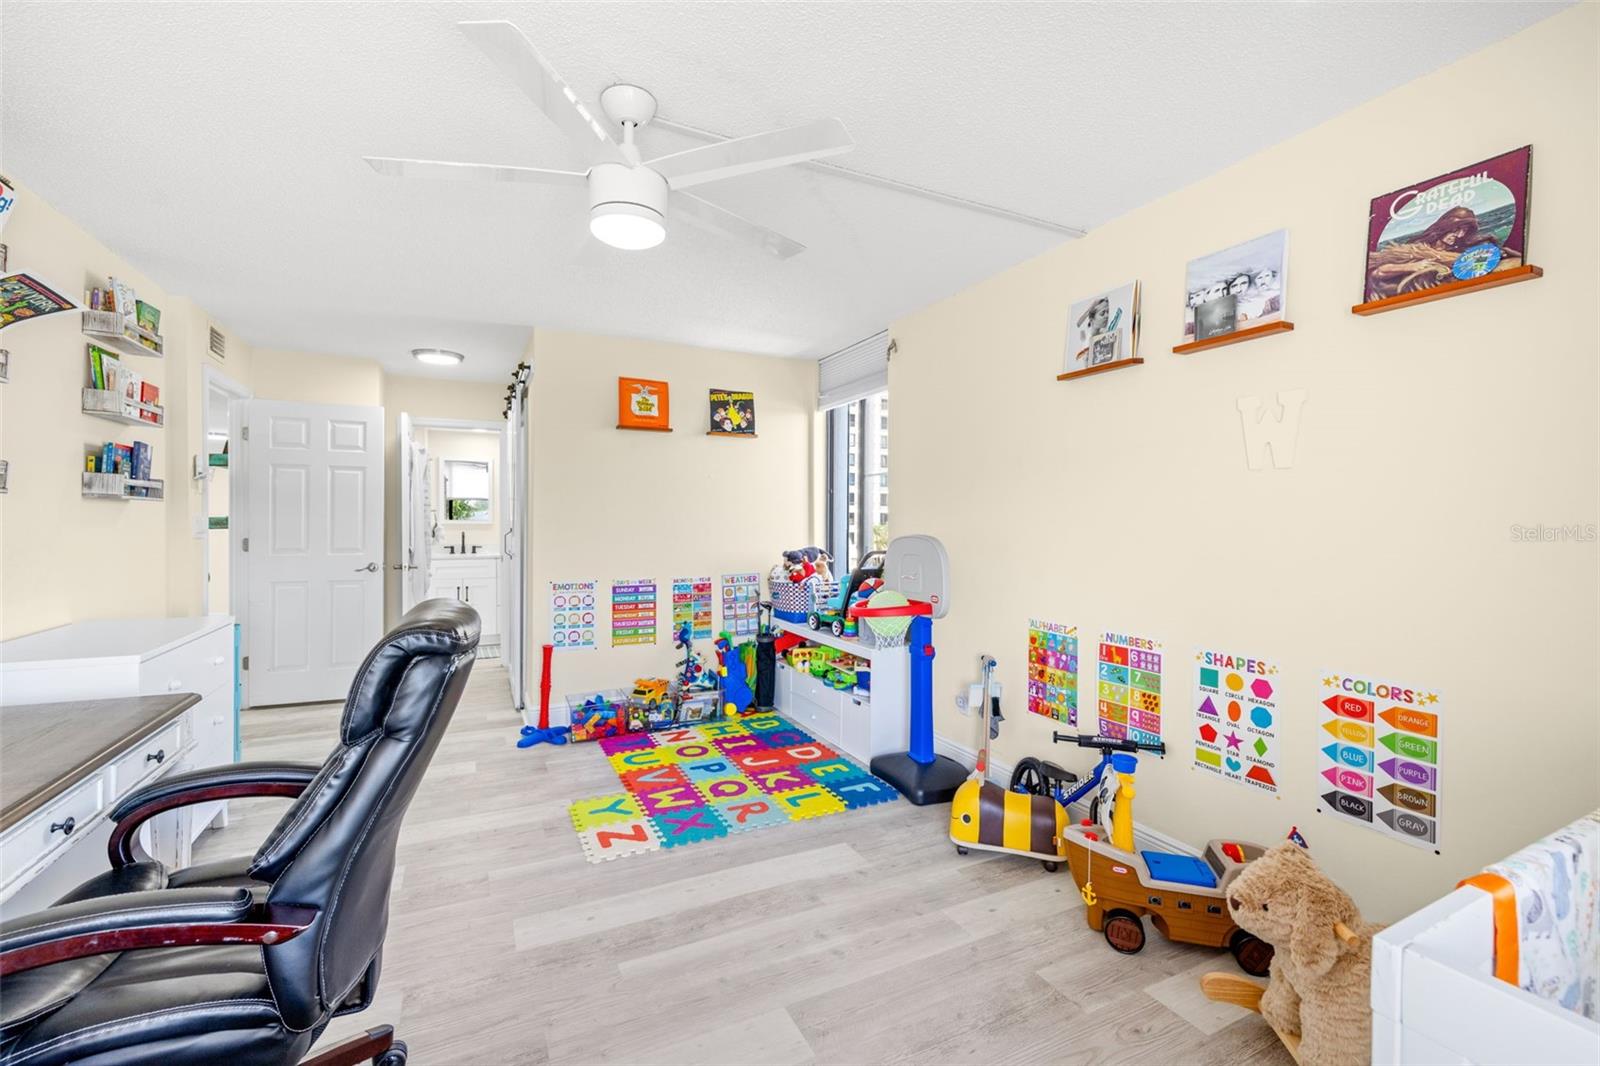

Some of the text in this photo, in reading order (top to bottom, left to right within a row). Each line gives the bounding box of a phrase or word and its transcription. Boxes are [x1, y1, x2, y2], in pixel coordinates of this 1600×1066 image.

[1390, 171, 1494, 219] GRATEFUL
[1426, 190, 1475, 214] DEAD
[27, 289, 58, 312] YORK
[1236, 388, 1307, 471] W
[725, 576, 757, 584] WEATHER
[552, 583, 594, 591] EMOTIONS
[1030, 619, 1067, 634] ALPHABET
[1106, 632, 1153, 650] NUMBERS
[1102, 645, 1107, 656] 1
[1131, 651, 1139, 662] 6
[1101, 664, 1108, 675] 2
[1205, 651, 1266, 675] SHAPES
[1134, 671, 1142, 682] 7
[1103, 684, 1109, 694] 3
[1134, 690, 1140, 701] 8
[1199, 686, 1219, 695] SQUARE
[1342, 678, 1414, 704] COLORS
[1225, 692, 1244, 701] CIRCLE
[1248, 697, 1276, 708] HEXAGON
[1100, 702, 1107, 712] 4
[1344, 703, 1362, 712] RED
[1131, 710, 1139, 722] 9
[1196, 712, 1220, 723] TRIANGLE
[1397, 714, 1429, 727] ORANGE
[705, 723, 740, 737] H
[1101, 720, 1107, 732] 5
[1226, 721, 1240, 729] OVAL
[661, 730, 696, 743] N
[1129, 729, 1139, 741] 10
[1247, 726, 1275, 738] OCTAGON
[676, 745, 709, 757] O
[722, 740, 756, 749] I
[1195, 740, 1221, 751] PENTAGON
[1399, 741, 1430, 754] GREEN
[623, 751, 661, 765] U
[786, 746, 822, 759] D
[1343, 751, 1364, 762] BLUE
[689, 762, 727, 773] P
[741, 757, 780, 766] J
[1194, 760, 1222, 774] RECTANGLE
[1246, 755, 1276, 768] DIAMOND
[636, 768, 678, 783] V
[811, 763, 849, 776] E
[1225, 772, 1242, 780] HEART
[1399, 766, 1427, 780] PURPLE
[758, 771, 801, 788] K
[1063, 769, 1094, 800] STRIDER
[1245, 778, 1277, 793] TRAPEZOID
[1341, 775, 1364, 788] PINK
[709, 780, 748, 797] Q
[840, 782, 881, 793] F
[648, 787, 696, 808] W
[786, 792, 821, 807] L
[1396, 792, 1428, 807] BROWN
[588, 799, 633, 815] Y
[727, 801, 769, 823] R
[1341, 799, 1365, 812] BLACK
[664, 812, 715, 835] X
[1399, 817, 1425, 833] GRAY
[596, 824, 649, 848] Z
